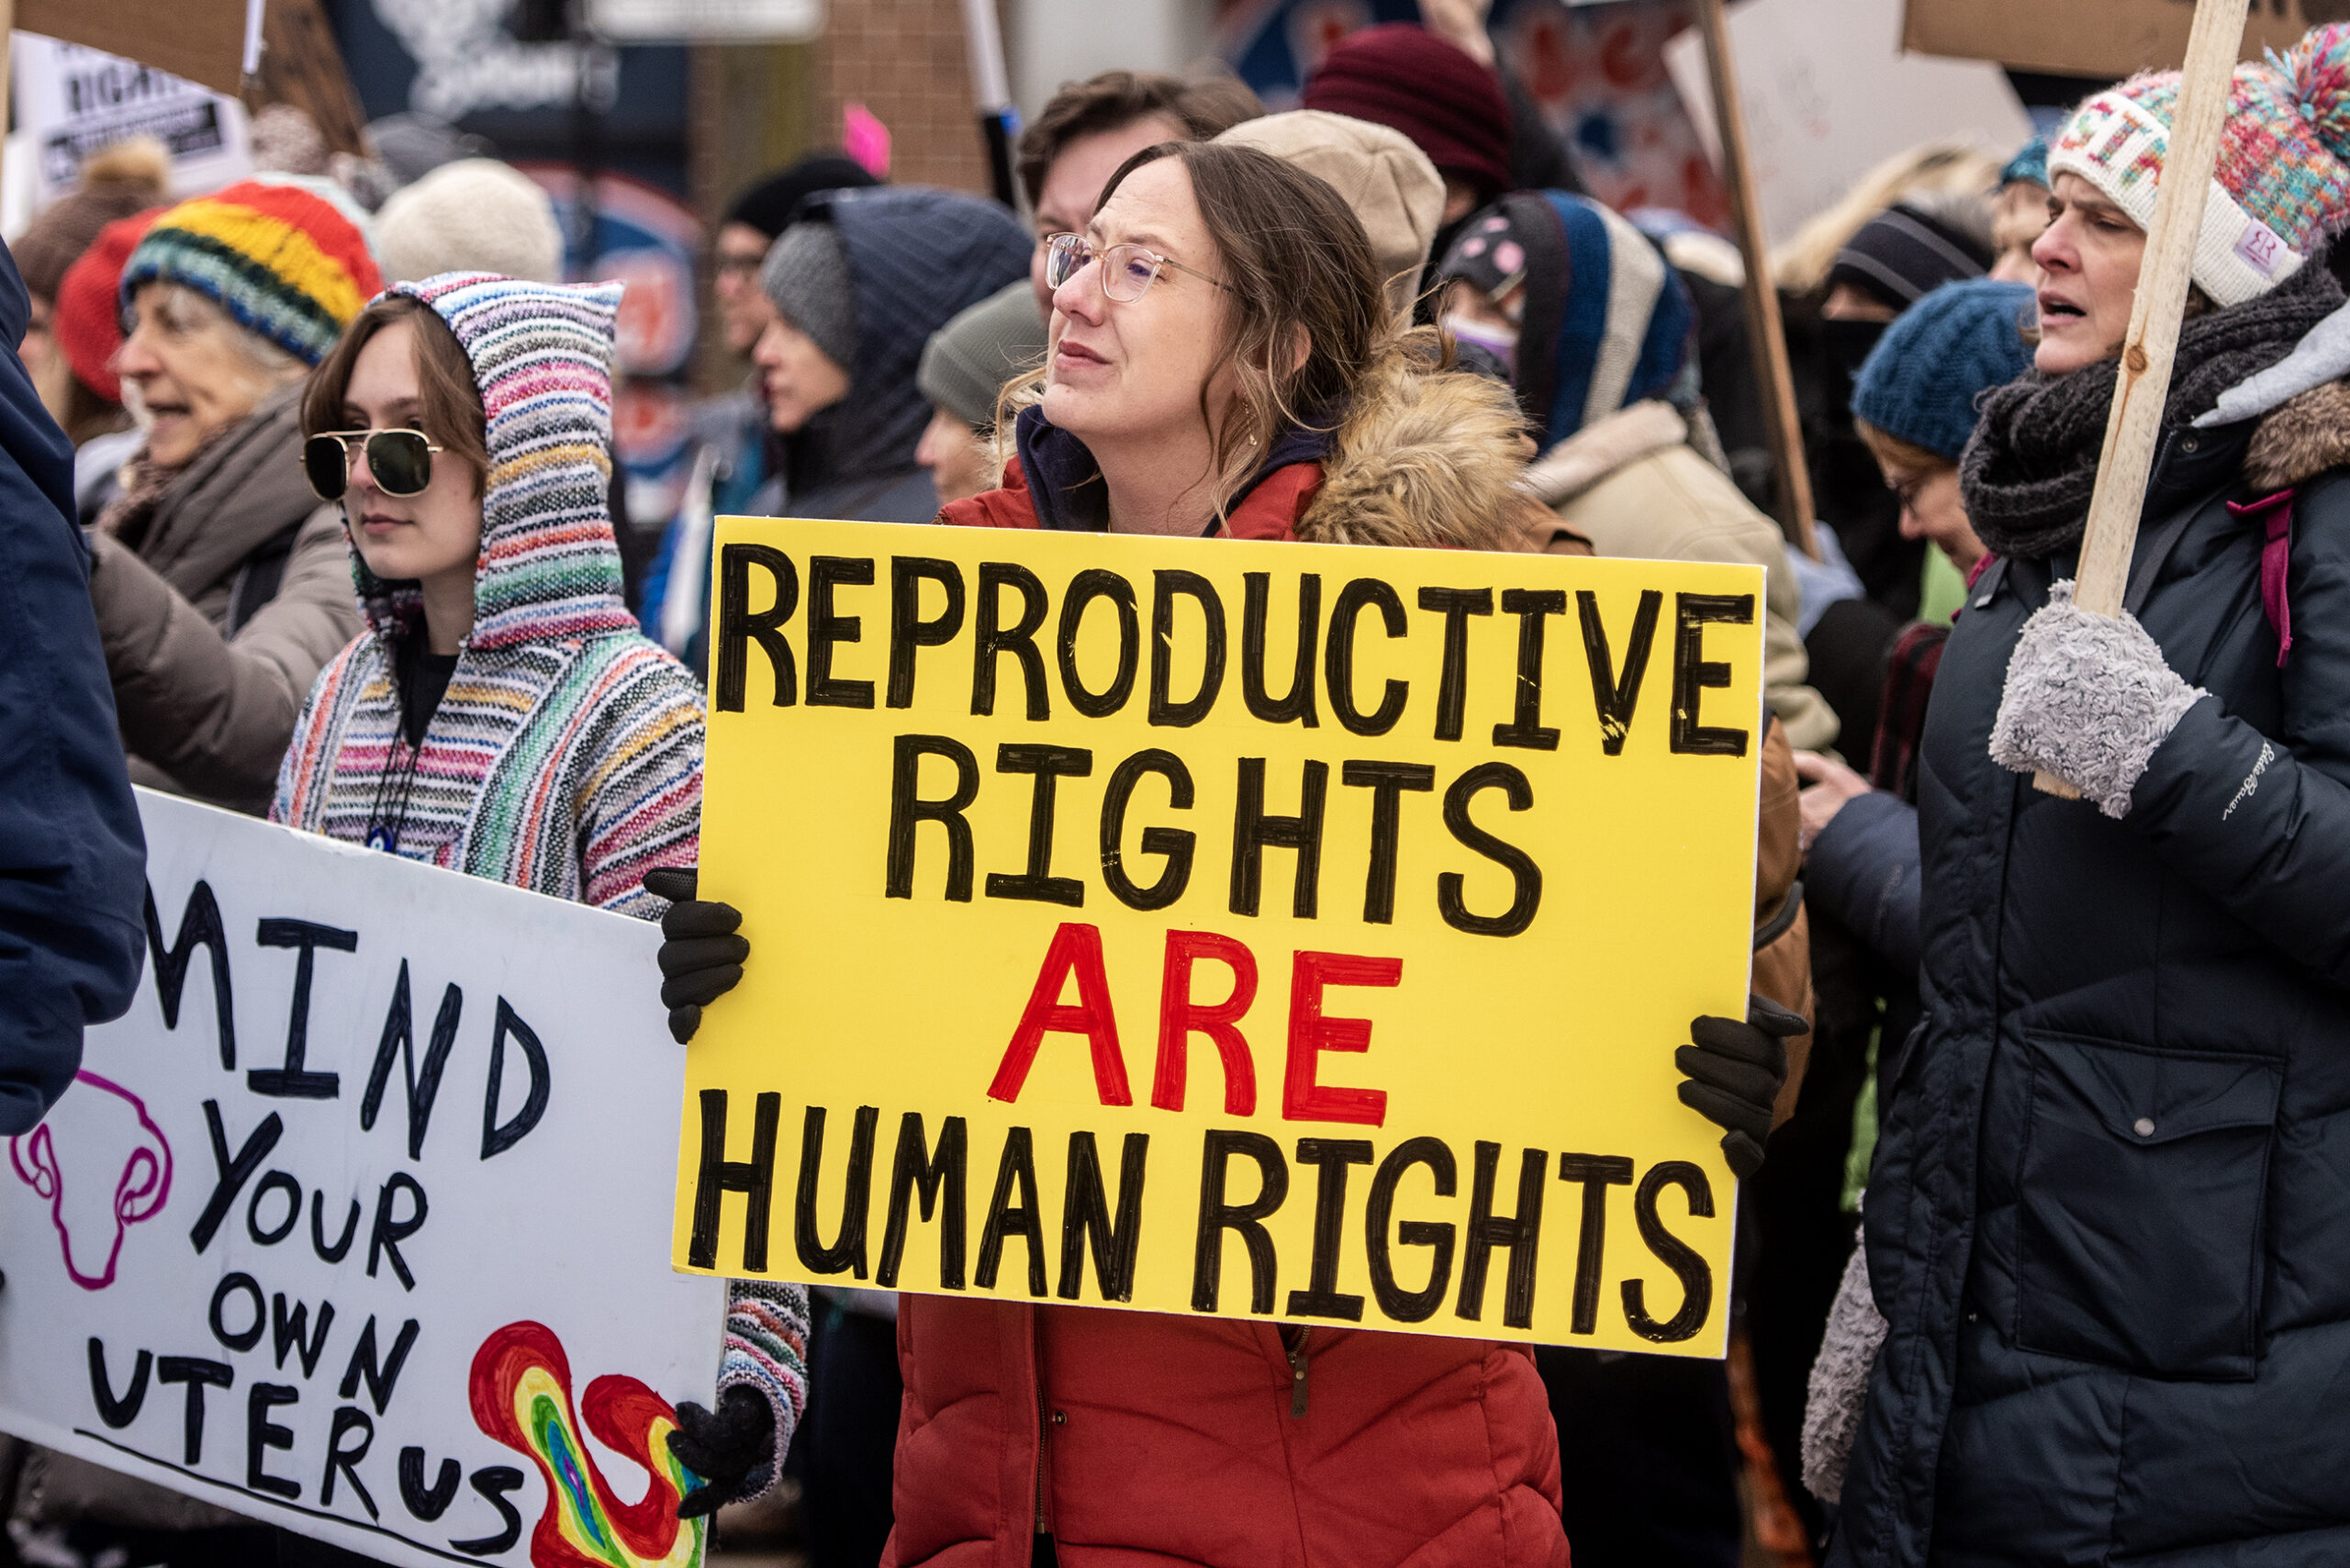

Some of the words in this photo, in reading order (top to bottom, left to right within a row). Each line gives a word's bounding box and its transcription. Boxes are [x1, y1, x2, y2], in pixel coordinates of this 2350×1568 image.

[716, 543, 1755, 757] REPRODUCTIVE
[885, 734, 1543, 938] RIGHTS
[144, 875, 551, 1160] MIND
[986, 922, 1403, 1128] ARE
[190, 1099, 429, 1292] YOUR
[688, 1088, 1149, 1303] HUMAN
[1191, 1128, 1716, 1344] RIGHTS
[88, 1336, 524, 1556] UTERUS
[209, 1271, 420, 1416] OWN
